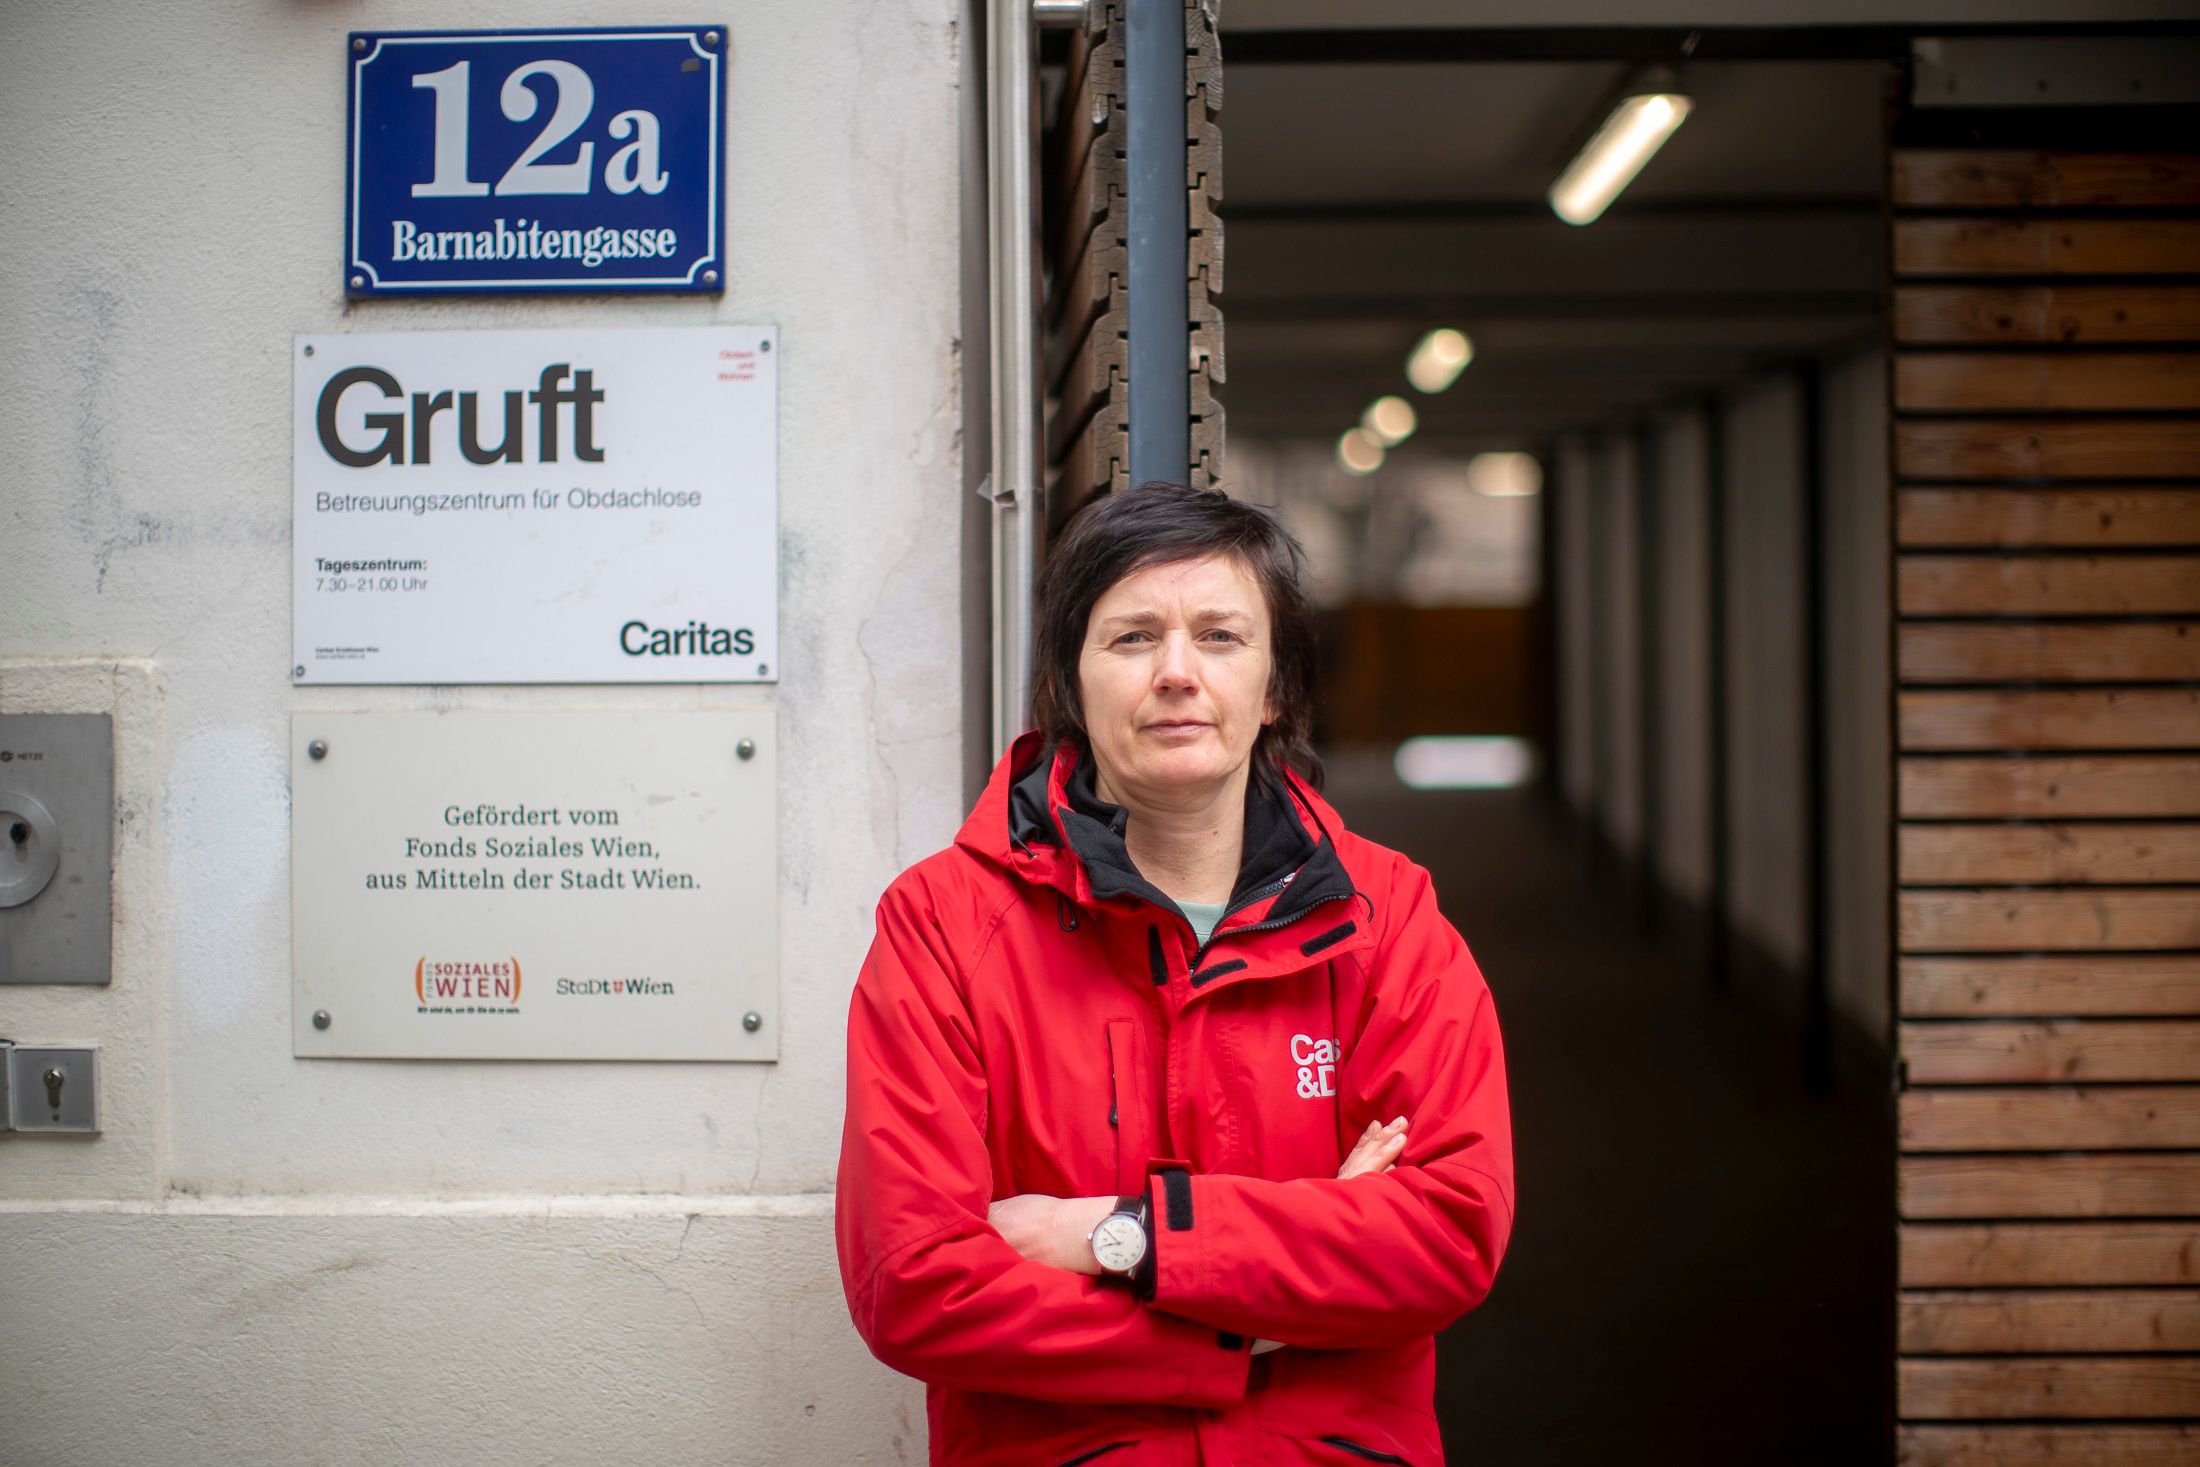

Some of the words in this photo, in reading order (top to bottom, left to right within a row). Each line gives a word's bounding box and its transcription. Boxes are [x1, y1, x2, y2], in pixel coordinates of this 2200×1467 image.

[411, 59, 669, 197] 12a
[392, 218, 677, 267] Barnabitengasse
[316, 363, 605, 467] Gruft
[316, 491, 526, 516] Betreuungszentrum
[532, 489, 560, 510] für
[567, 487, 702, 509] Obdachlose
[316, 558, 427, 574] Tageszentrum:
[401, 576, 428, 592] Uhr
[620, 620, 755, 656] Caritas
[444, 804, 561, 826] Gefördert
[568, 808, 619, 826] vom
[405, 837, 477, 859] Fonds
[485, 836, 584, 859] Soziales
[591, 837, 661, 861] Wien,
[366, 872, 407, 890] aus
[415, 868, 504, 890] Mitteln
[513, 868, 553, 890] der
[560, 868, 626, 890] Stadt
[632, 868, 701, 890] Wien.
[434, 963, 510, 976] SOZIALES
[435, 978, 510, 998] WIEN
[625, 977, 675, 995] Wien
